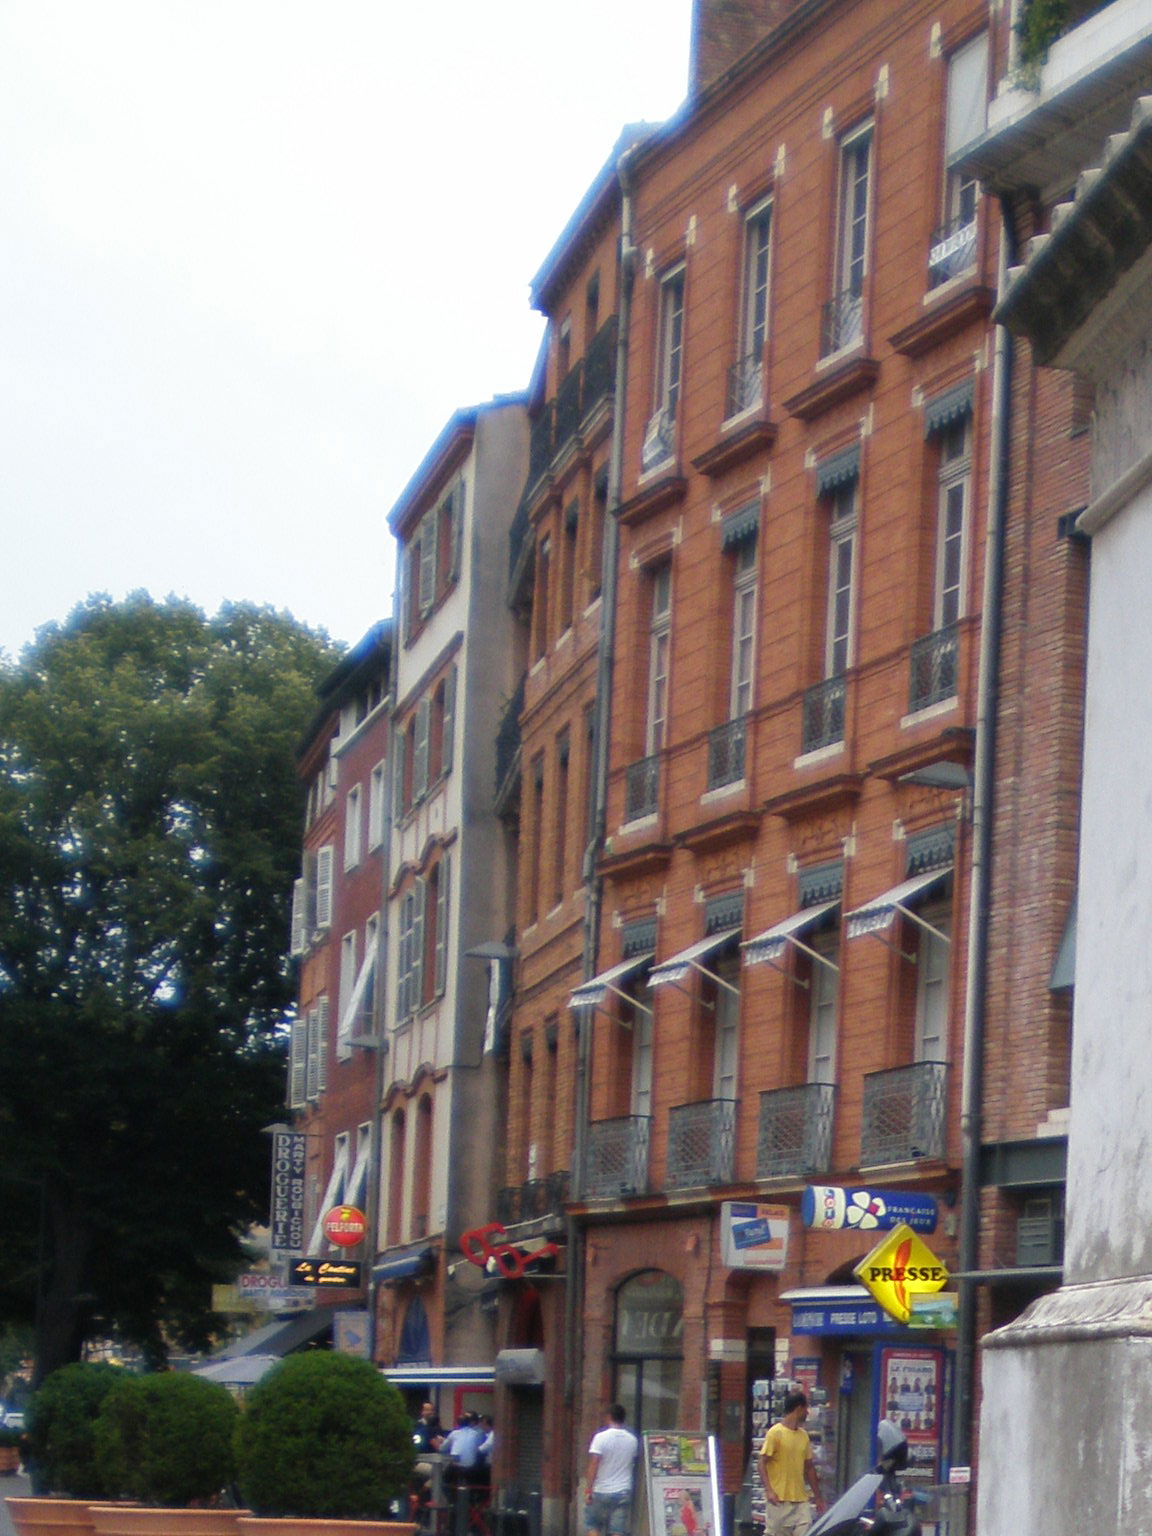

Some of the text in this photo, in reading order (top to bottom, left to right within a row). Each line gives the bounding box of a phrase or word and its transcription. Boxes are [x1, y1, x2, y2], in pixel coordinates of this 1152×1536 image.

[293, 1136, 305, 1174] MARTY
[275, 1135, 290, 1247] DROGUERIE
[870, 1267, 943, 1282] PRESSE
[830, 1312, 857, 1325] PRESSE
[858, 1311, 878, 1324] LOTO
